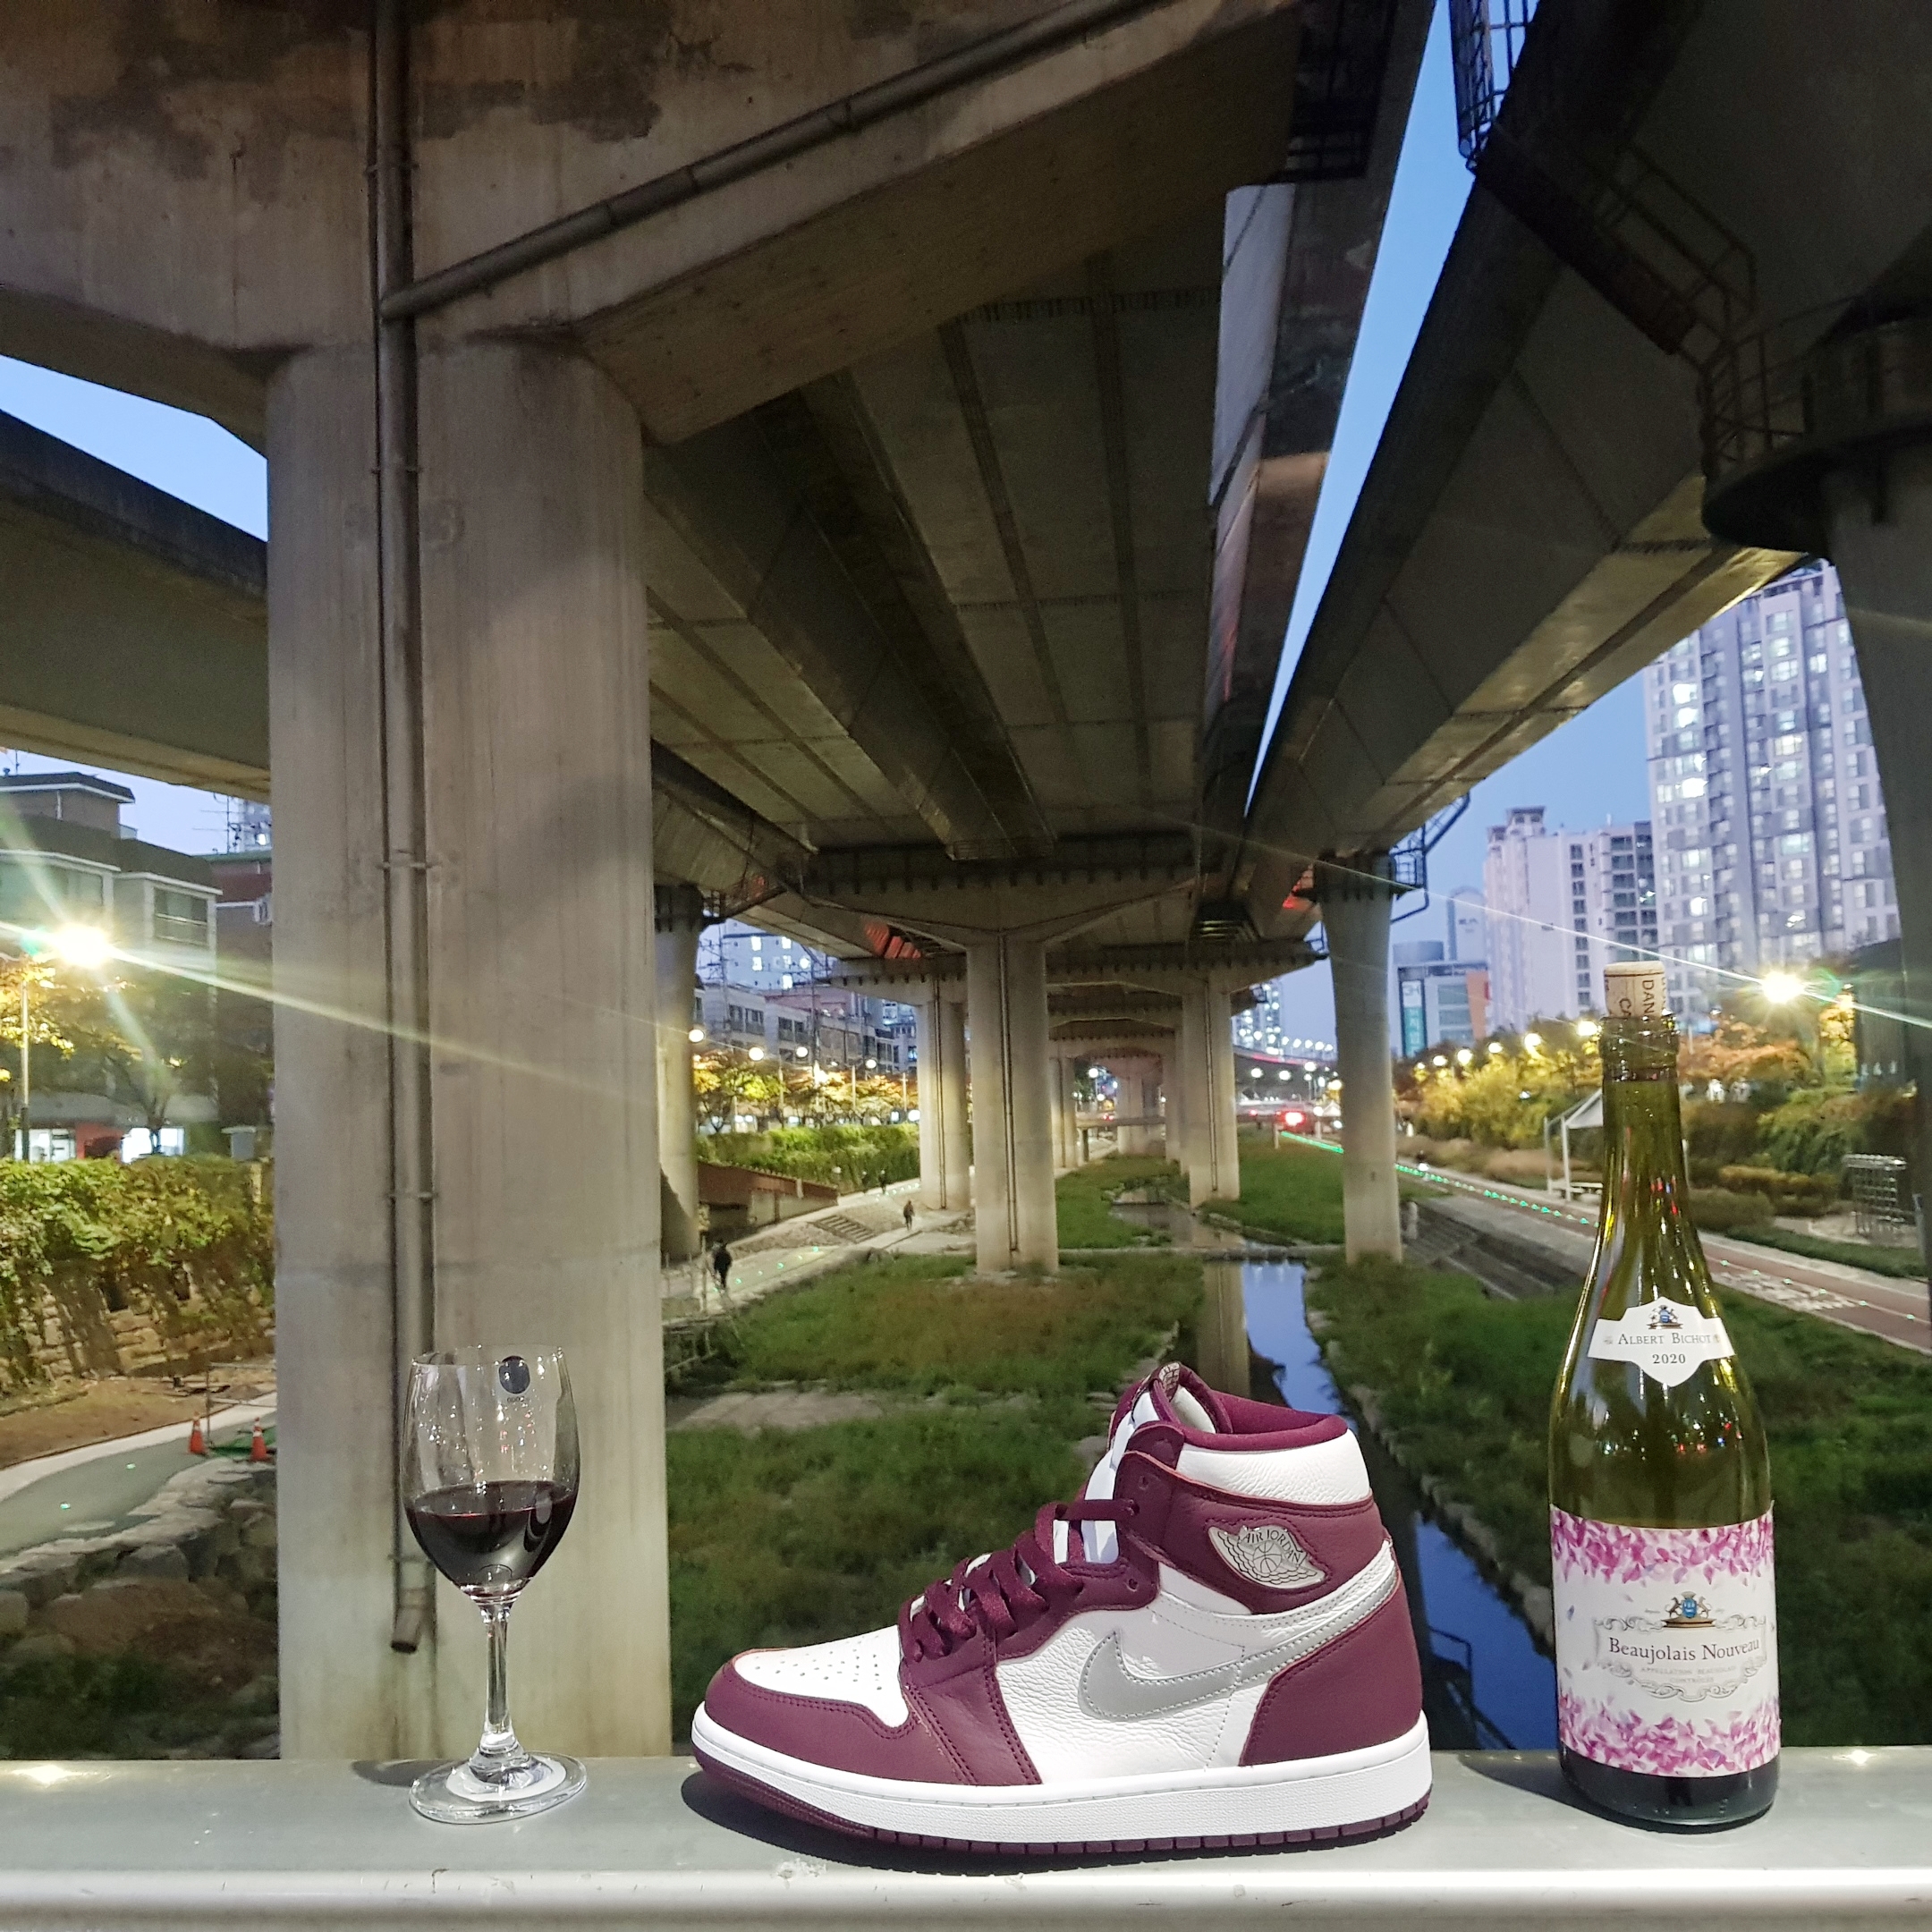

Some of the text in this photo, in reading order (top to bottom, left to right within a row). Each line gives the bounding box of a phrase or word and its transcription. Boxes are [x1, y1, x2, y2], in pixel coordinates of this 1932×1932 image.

[1618, 1333, 1710, 1345] ALBERT BICHOT
[1652, 1353, 1686, 1365] 2020
[1242, 1529, 1301, 1563] AIR JORDAN
[1609, 1637, 1759, 1665] Beaujolais Nouveau
